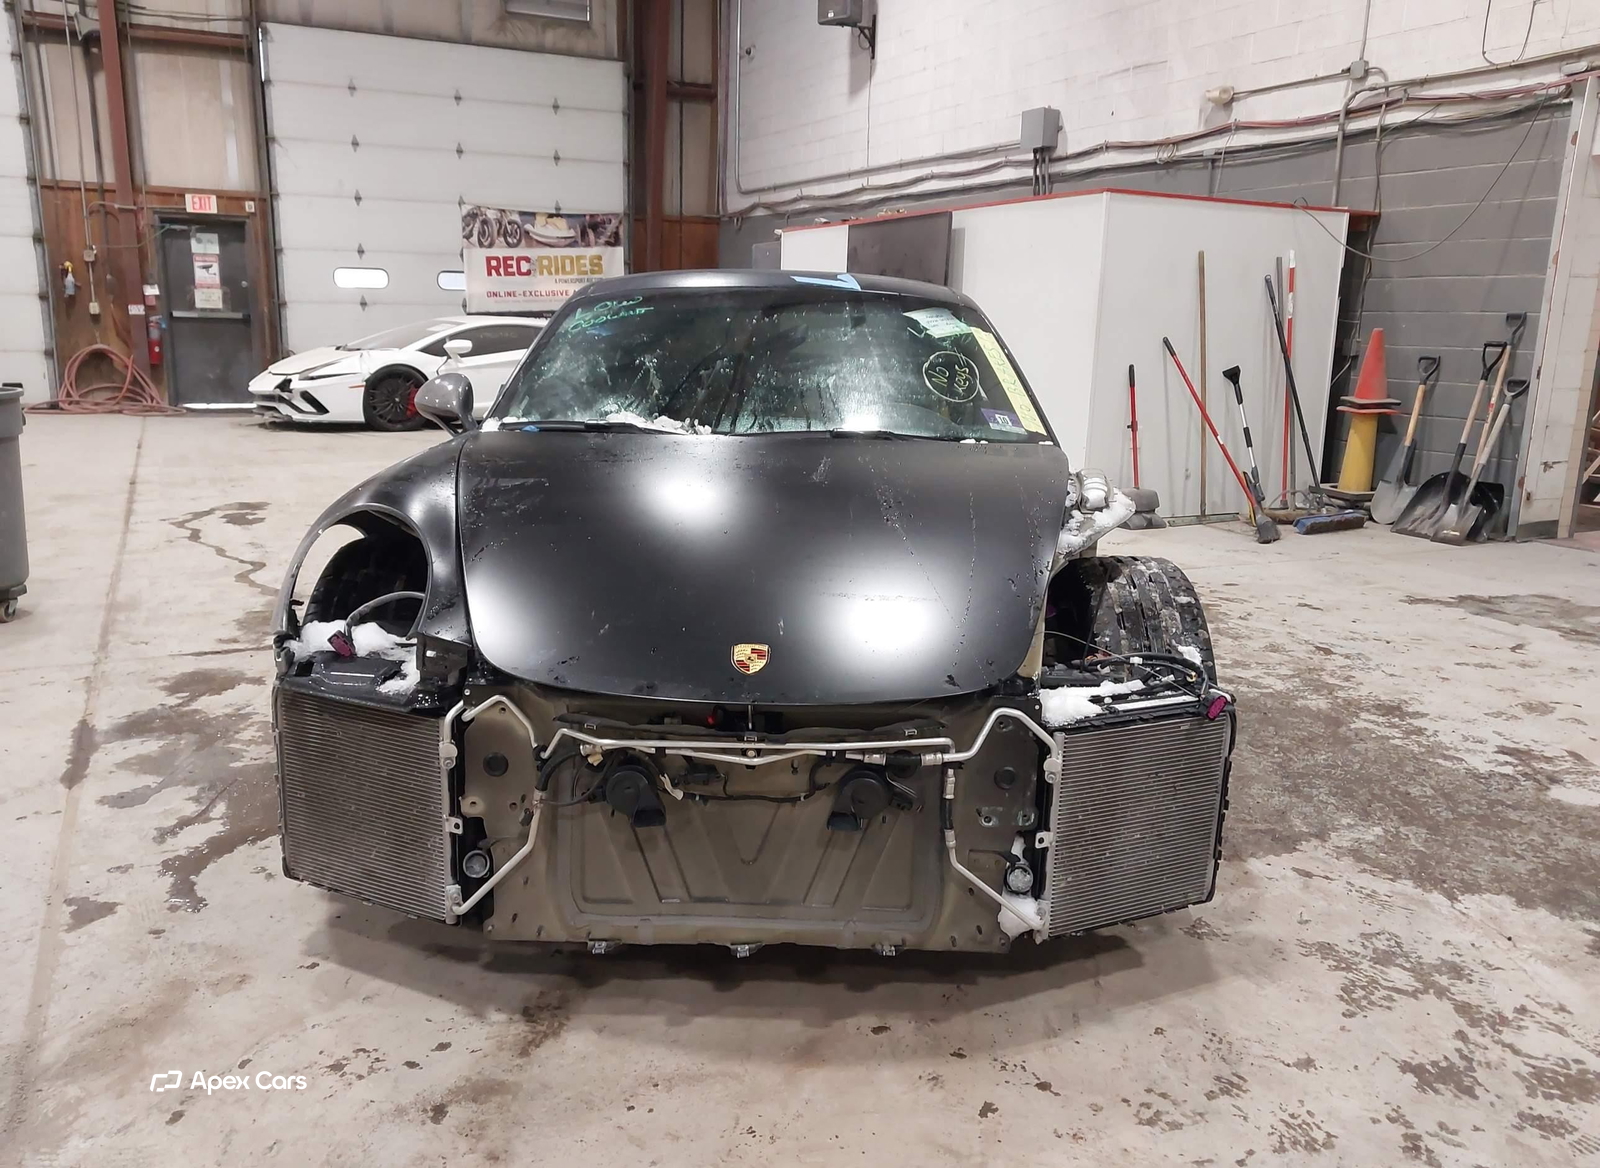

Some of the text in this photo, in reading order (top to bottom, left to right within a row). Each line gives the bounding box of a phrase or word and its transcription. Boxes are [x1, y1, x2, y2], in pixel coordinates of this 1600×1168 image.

[191, 195, 212, 211] EXIT
[485, 255, 532, 277] REC
[537, 254, 603, 277] RIDES
[486, 290, 570, 298] ONLINE-EXCLUSIVE
